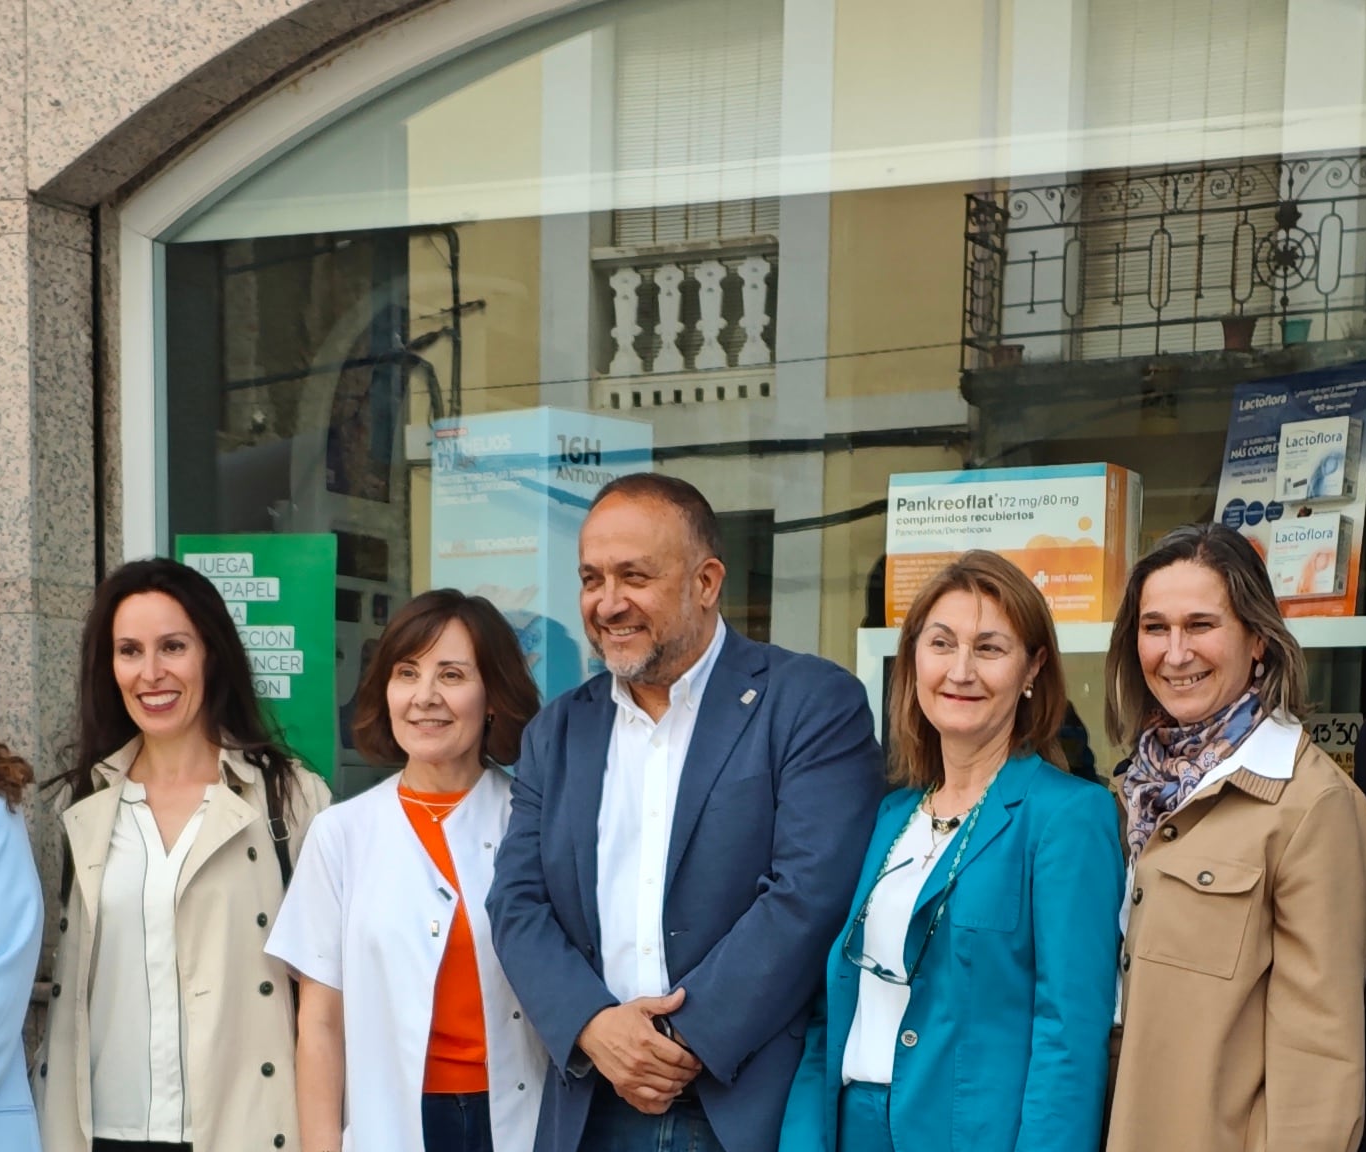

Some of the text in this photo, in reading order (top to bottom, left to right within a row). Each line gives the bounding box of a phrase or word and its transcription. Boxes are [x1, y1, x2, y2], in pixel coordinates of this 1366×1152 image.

[1239, 393, 1287, 411] Lactoflora
[1286, 431, 1343, 448] Lactoflora
[557, 434, 602, 466] 16H
[556, 466, 619, 489] ANTIOXID
[1060, 495, 1080, 507] mg
[896, 511, 1034, 526] comprimidos recubiertos
[1275, 528, 1334, 544] Lactoflora
[198, 557, 250, 573] JUEGA
[222, 581, 277, 598] PAPEL
[250, 655, 301, 671] NCER
